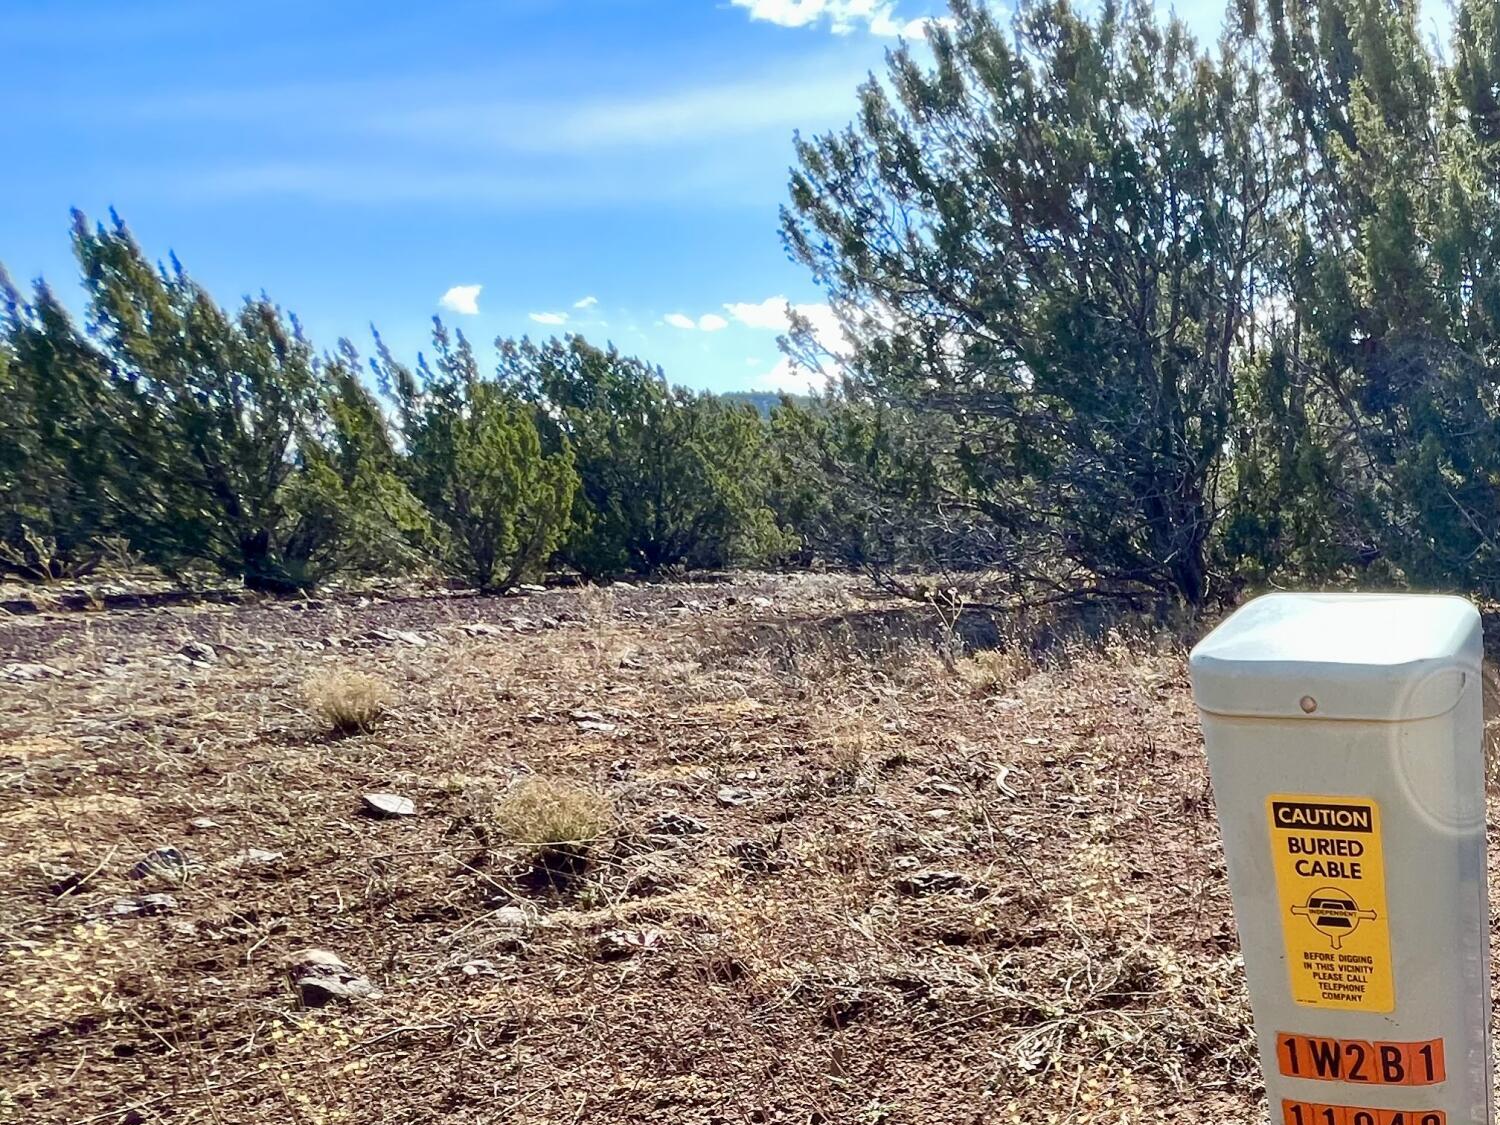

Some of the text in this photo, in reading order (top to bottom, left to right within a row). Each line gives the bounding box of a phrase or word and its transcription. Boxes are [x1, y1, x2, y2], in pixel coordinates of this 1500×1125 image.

[1278, 807, 1368, 828] CAUTION
[1288, 836, 1364, 857] BURIED
[1295, 859, 1362, 880] CABLE
[1309, 909, 1357, 918] INDEPENDENT
[1303, 952, 1372, 964] BEFORE DIGGING
[1303, 962, 1374, 974] IN THIS VICINITY
[1312, 972, 1368, 983] PLEASE CALL
[1319, 982, 1365, 992] TELEPHONE
[1321, 992, 1362, 1001] COMPANY
[1284, 1038, 1434, 1083] 1W2B1
